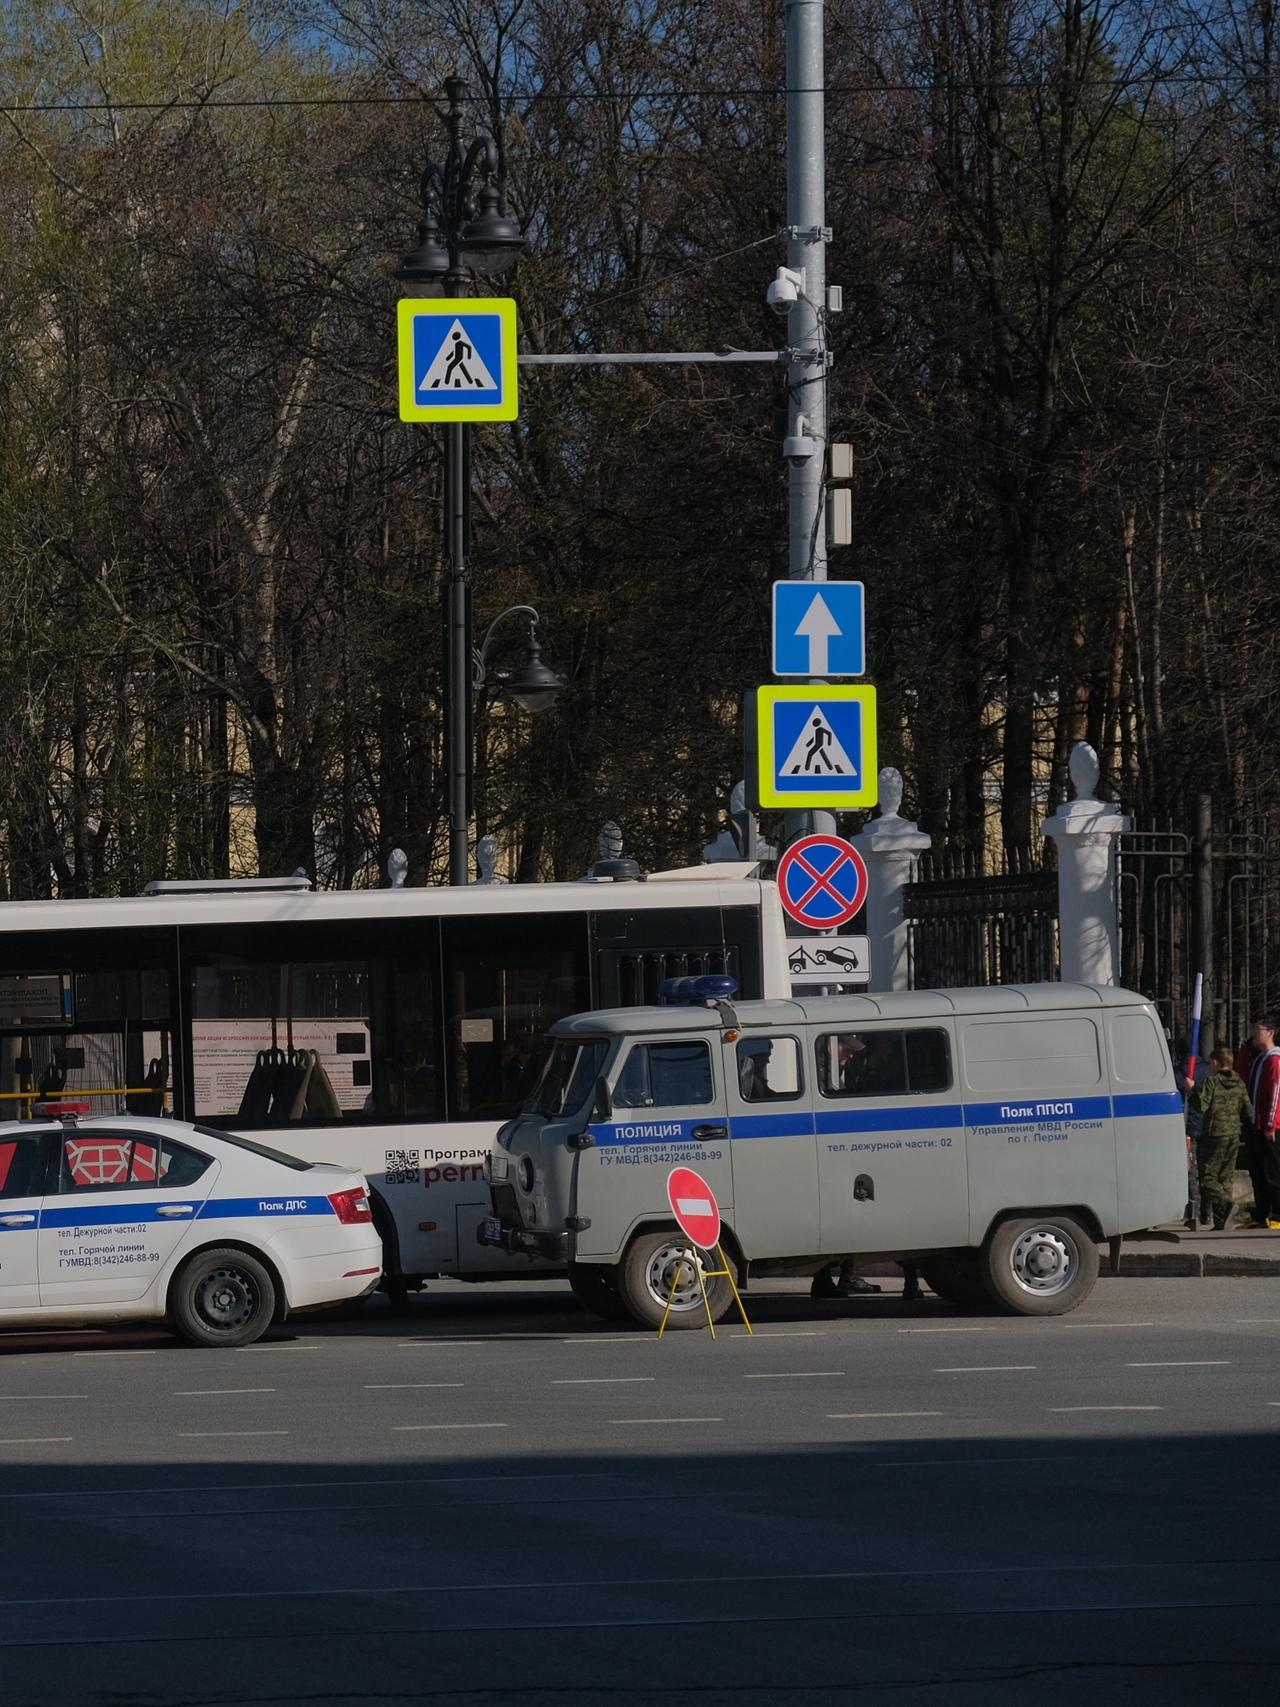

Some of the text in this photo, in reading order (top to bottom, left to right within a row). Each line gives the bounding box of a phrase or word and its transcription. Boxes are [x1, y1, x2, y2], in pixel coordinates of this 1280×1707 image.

[1000, 1103, 1073, 1118] Полк ППСП
[615, 1125, 682, 1139] ПОЛИЦИЯ
[972, 1121, 1103, 1136] Управление МВД России
[1034, 1133, 1068, 1143] Перми
[600, 1143, 702, 1155] тел. Горячей линии
[827, 1138, 952, 1153] тел. дежурной части: 02
[424, 1149, 492, 1161] Програм
[600, 1156, 612, 1165] ГУ
[259, 1200, 307, 1211] Полк ДПС
[59, 1244, 145, 1256] тел. Горячей линии
